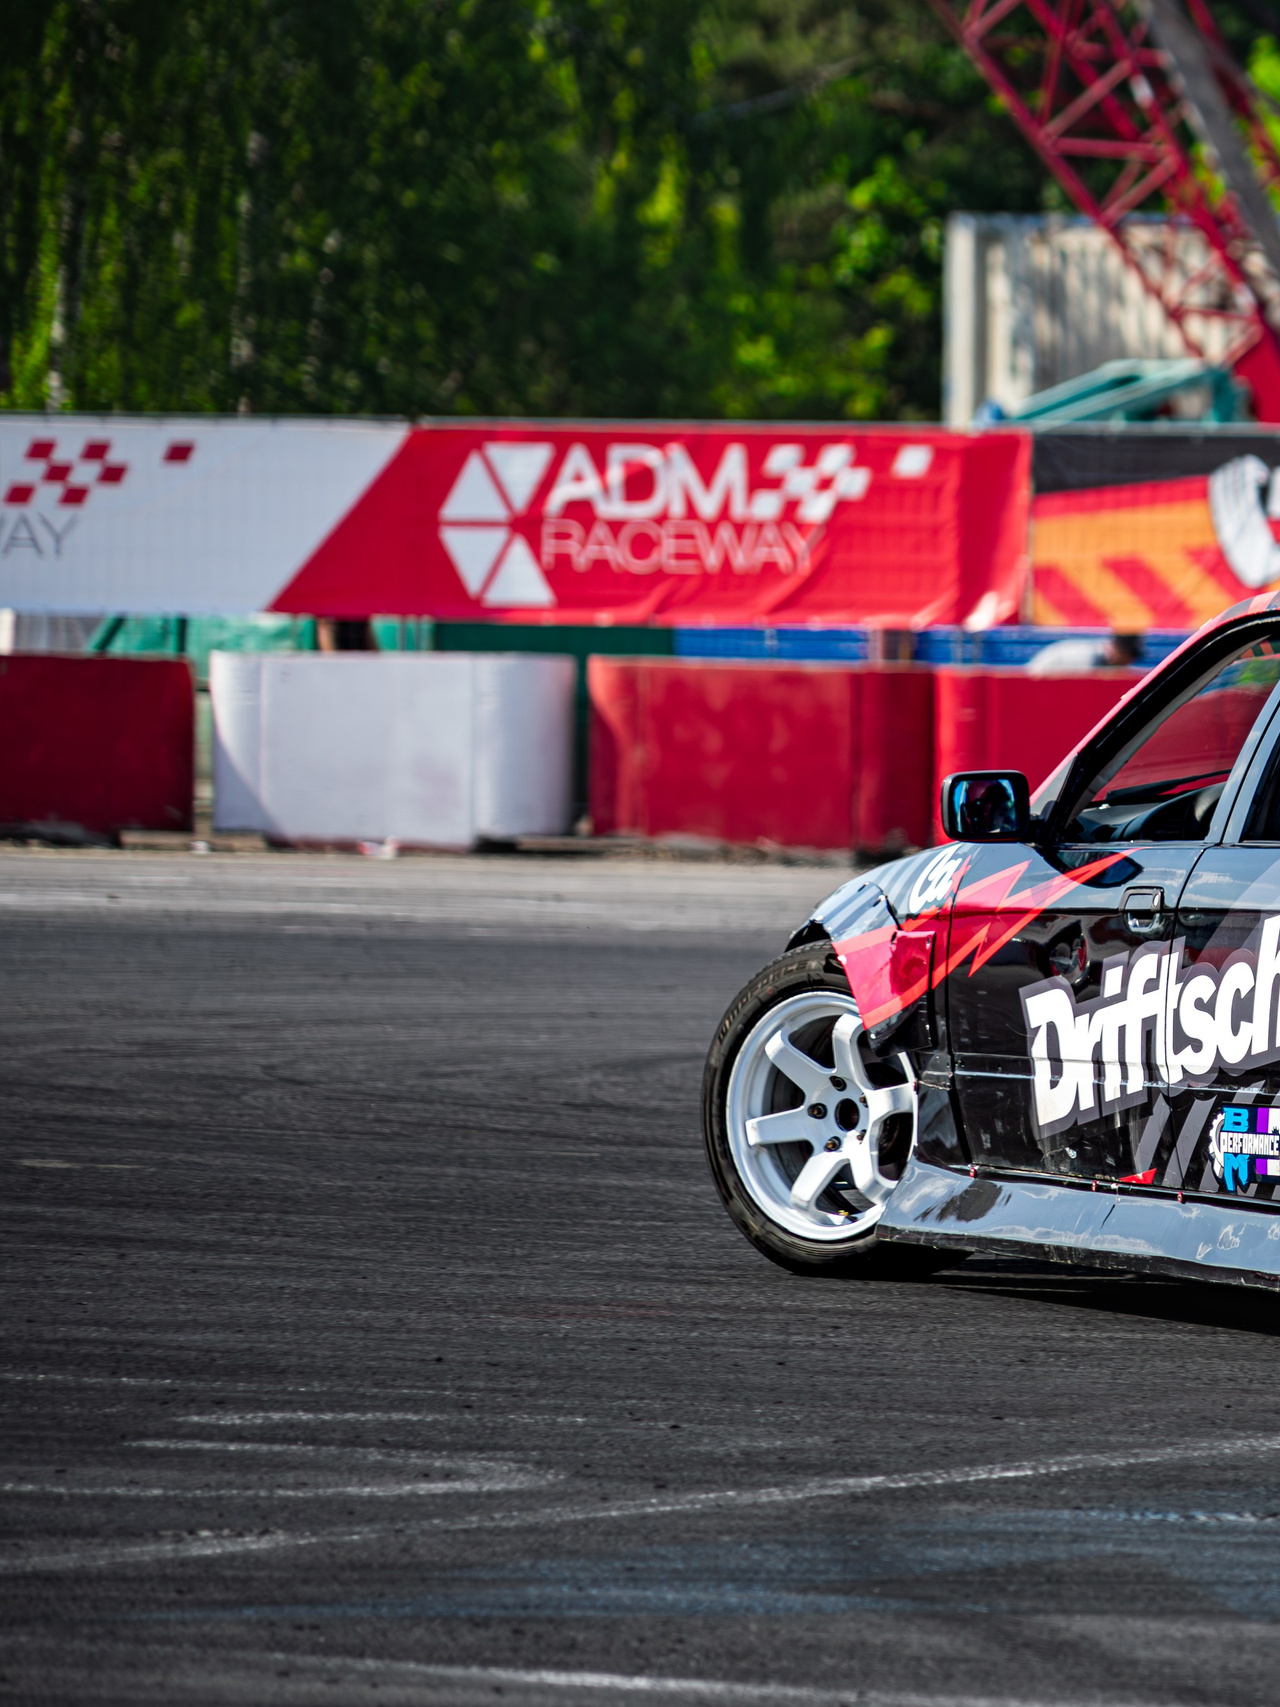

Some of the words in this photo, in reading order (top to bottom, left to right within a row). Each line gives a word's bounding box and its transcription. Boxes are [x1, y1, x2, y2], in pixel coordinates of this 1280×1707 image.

[546, 442, 750, 520] ADM
[0, 511, 80, 559] AY
[542, 519, 826, 575] RACEWAY
[1219, 1131, 1280, 1156] PERFORMANCE
